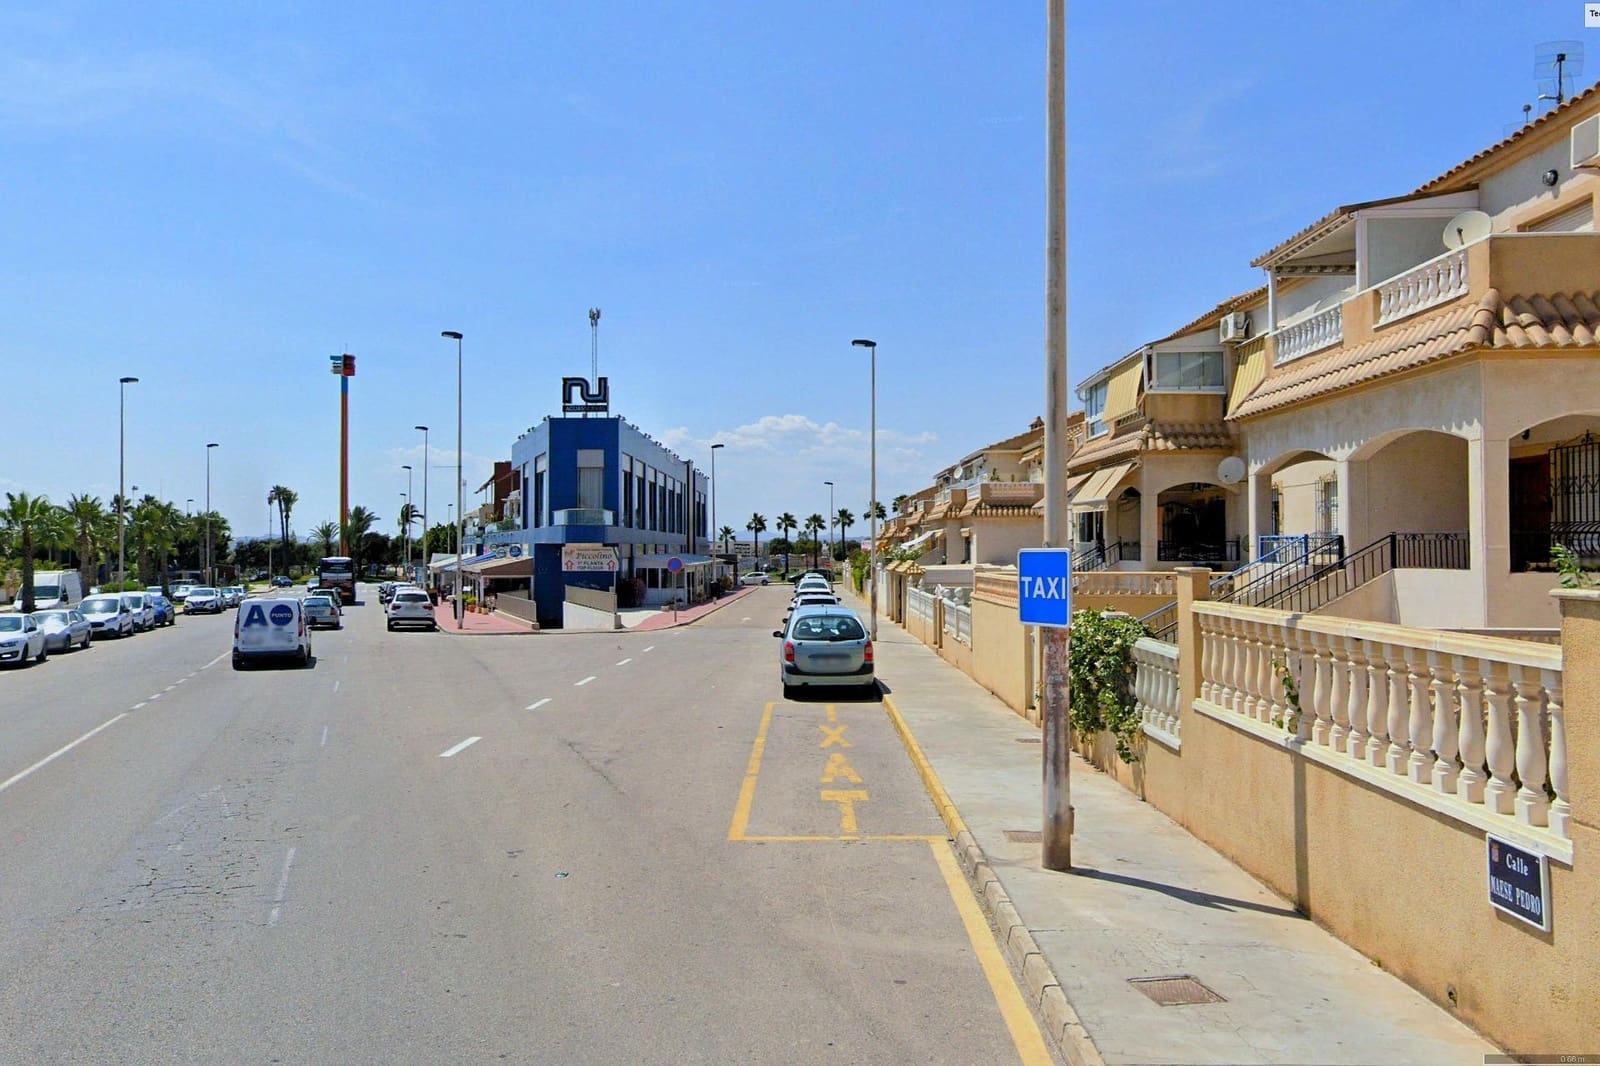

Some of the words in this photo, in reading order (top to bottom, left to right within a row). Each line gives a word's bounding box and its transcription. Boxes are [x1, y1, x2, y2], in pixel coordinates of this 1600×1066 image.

[1021, 576, 1066, 600] TAXI
[243, 605, 268, 628] A
[1506, 853, 1529, 876] Calle
[1490, 875, 1513, 902] MAESE
[1515, 887, 1541, 915] PEDRO
